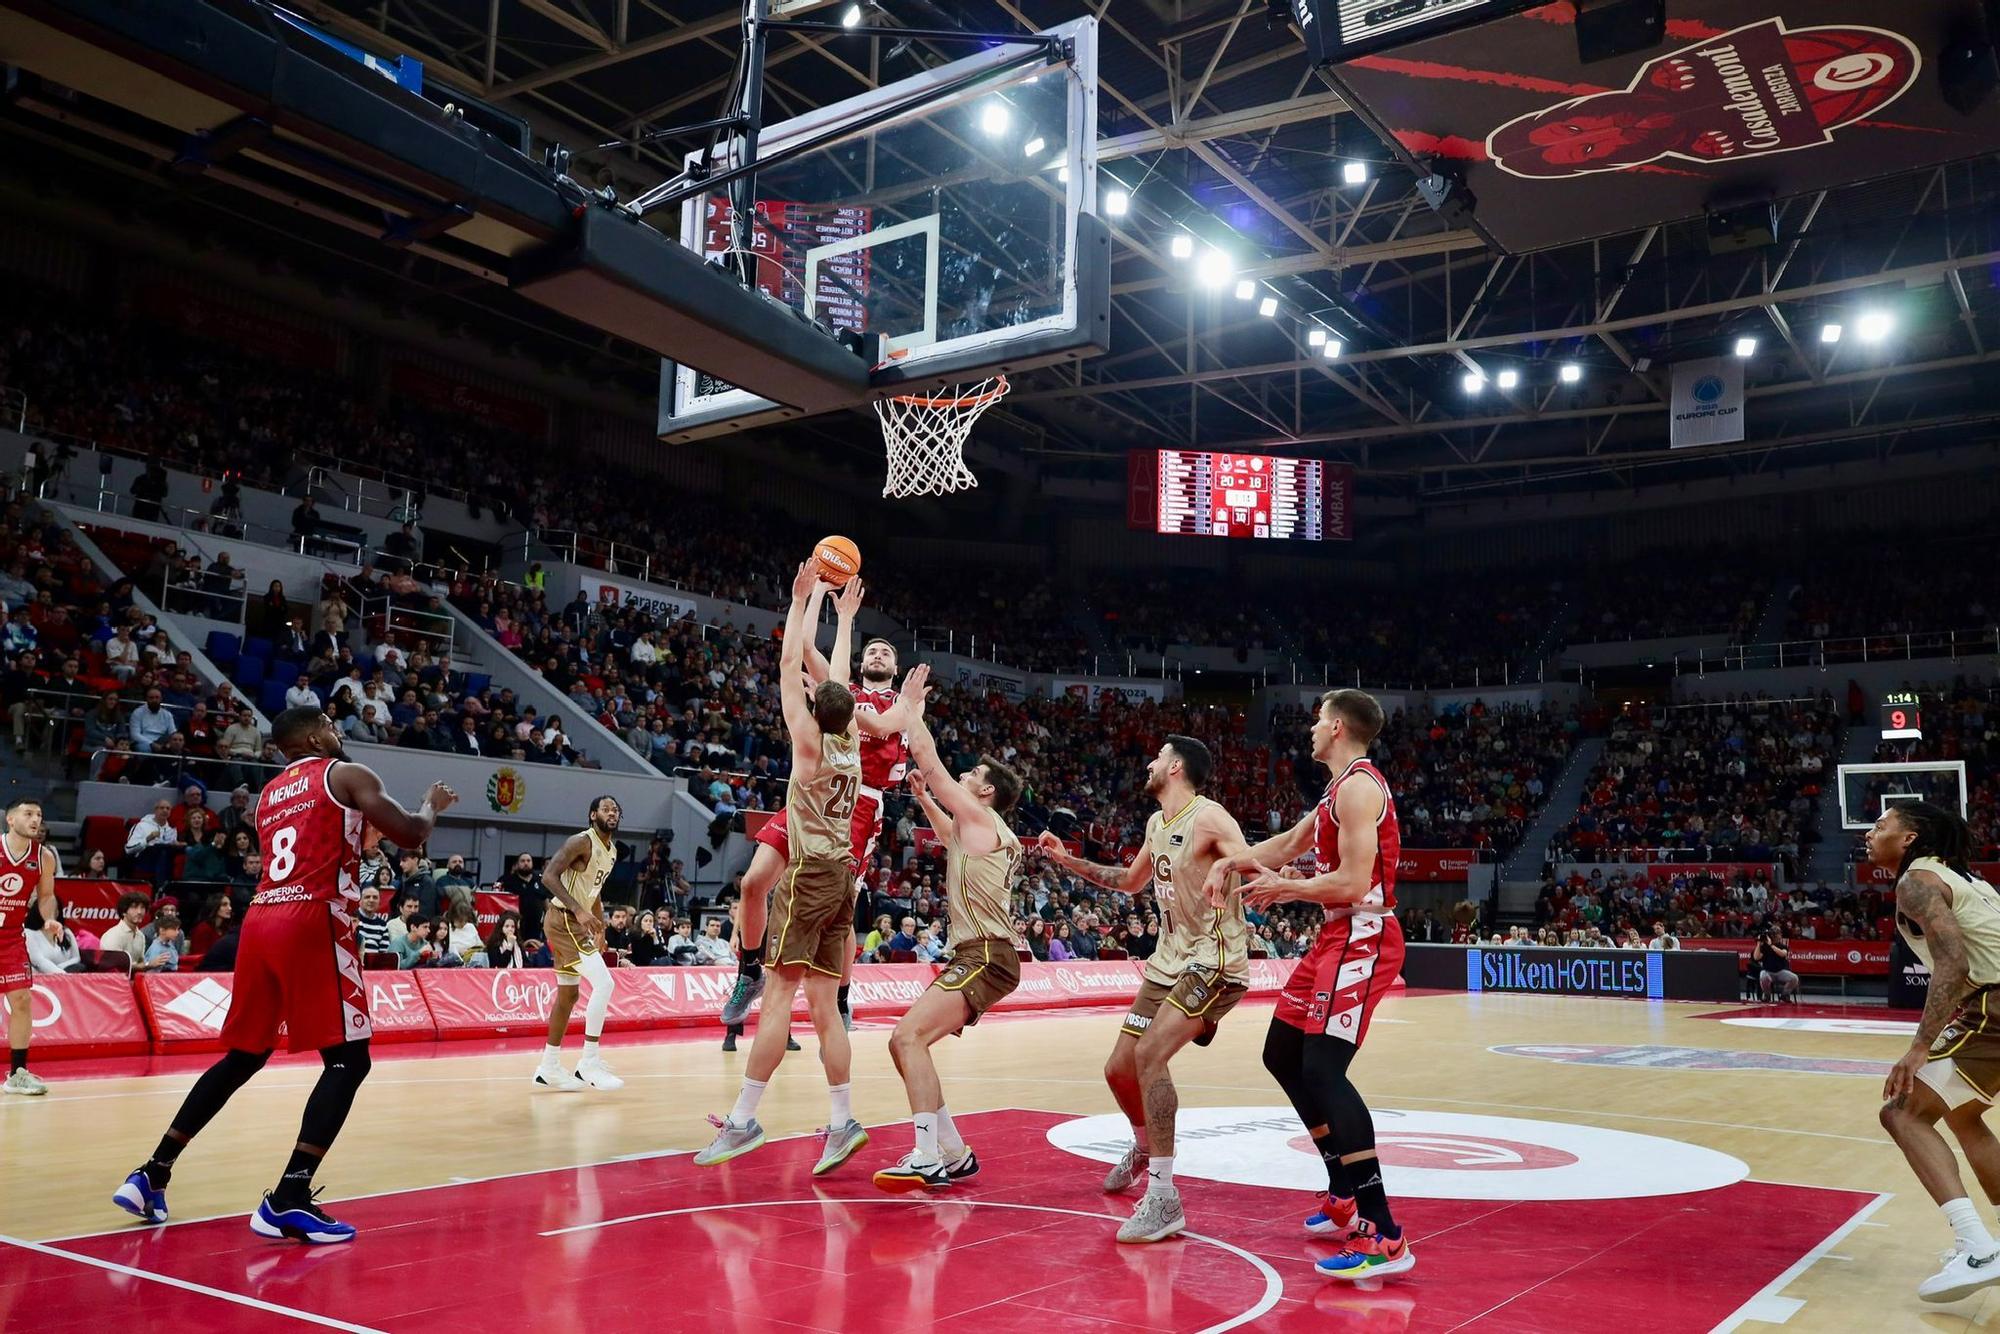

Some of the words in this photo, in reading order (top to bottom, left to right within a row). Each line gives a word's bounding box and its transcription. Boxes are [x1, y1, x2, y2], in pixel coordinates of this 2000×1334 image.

[1696, 44, 1781, 149] Casademont
[1762, 63, 1802, 116] ZARAGOZA
[1676, 410, 1716, 420] EUROPE
[1718, 407, 1738, 416] CUP
[1330, 480, 1345, 536] AMBAR
[822, 550, 851, 571] Wilson
[624, 590, 680, 615] Zaragoza
[1887, 693, 1912, 703] 1:14
[1891, 710, 1906, 729] 9
[268, 776, 309, 807] MENCÍA
[822, 773, 858, 820] 29
[269, 825, 297, 882] 8
[1483, 952, 1556, 989] Silken
[1557, 958, 1646, 993] HOTELES
